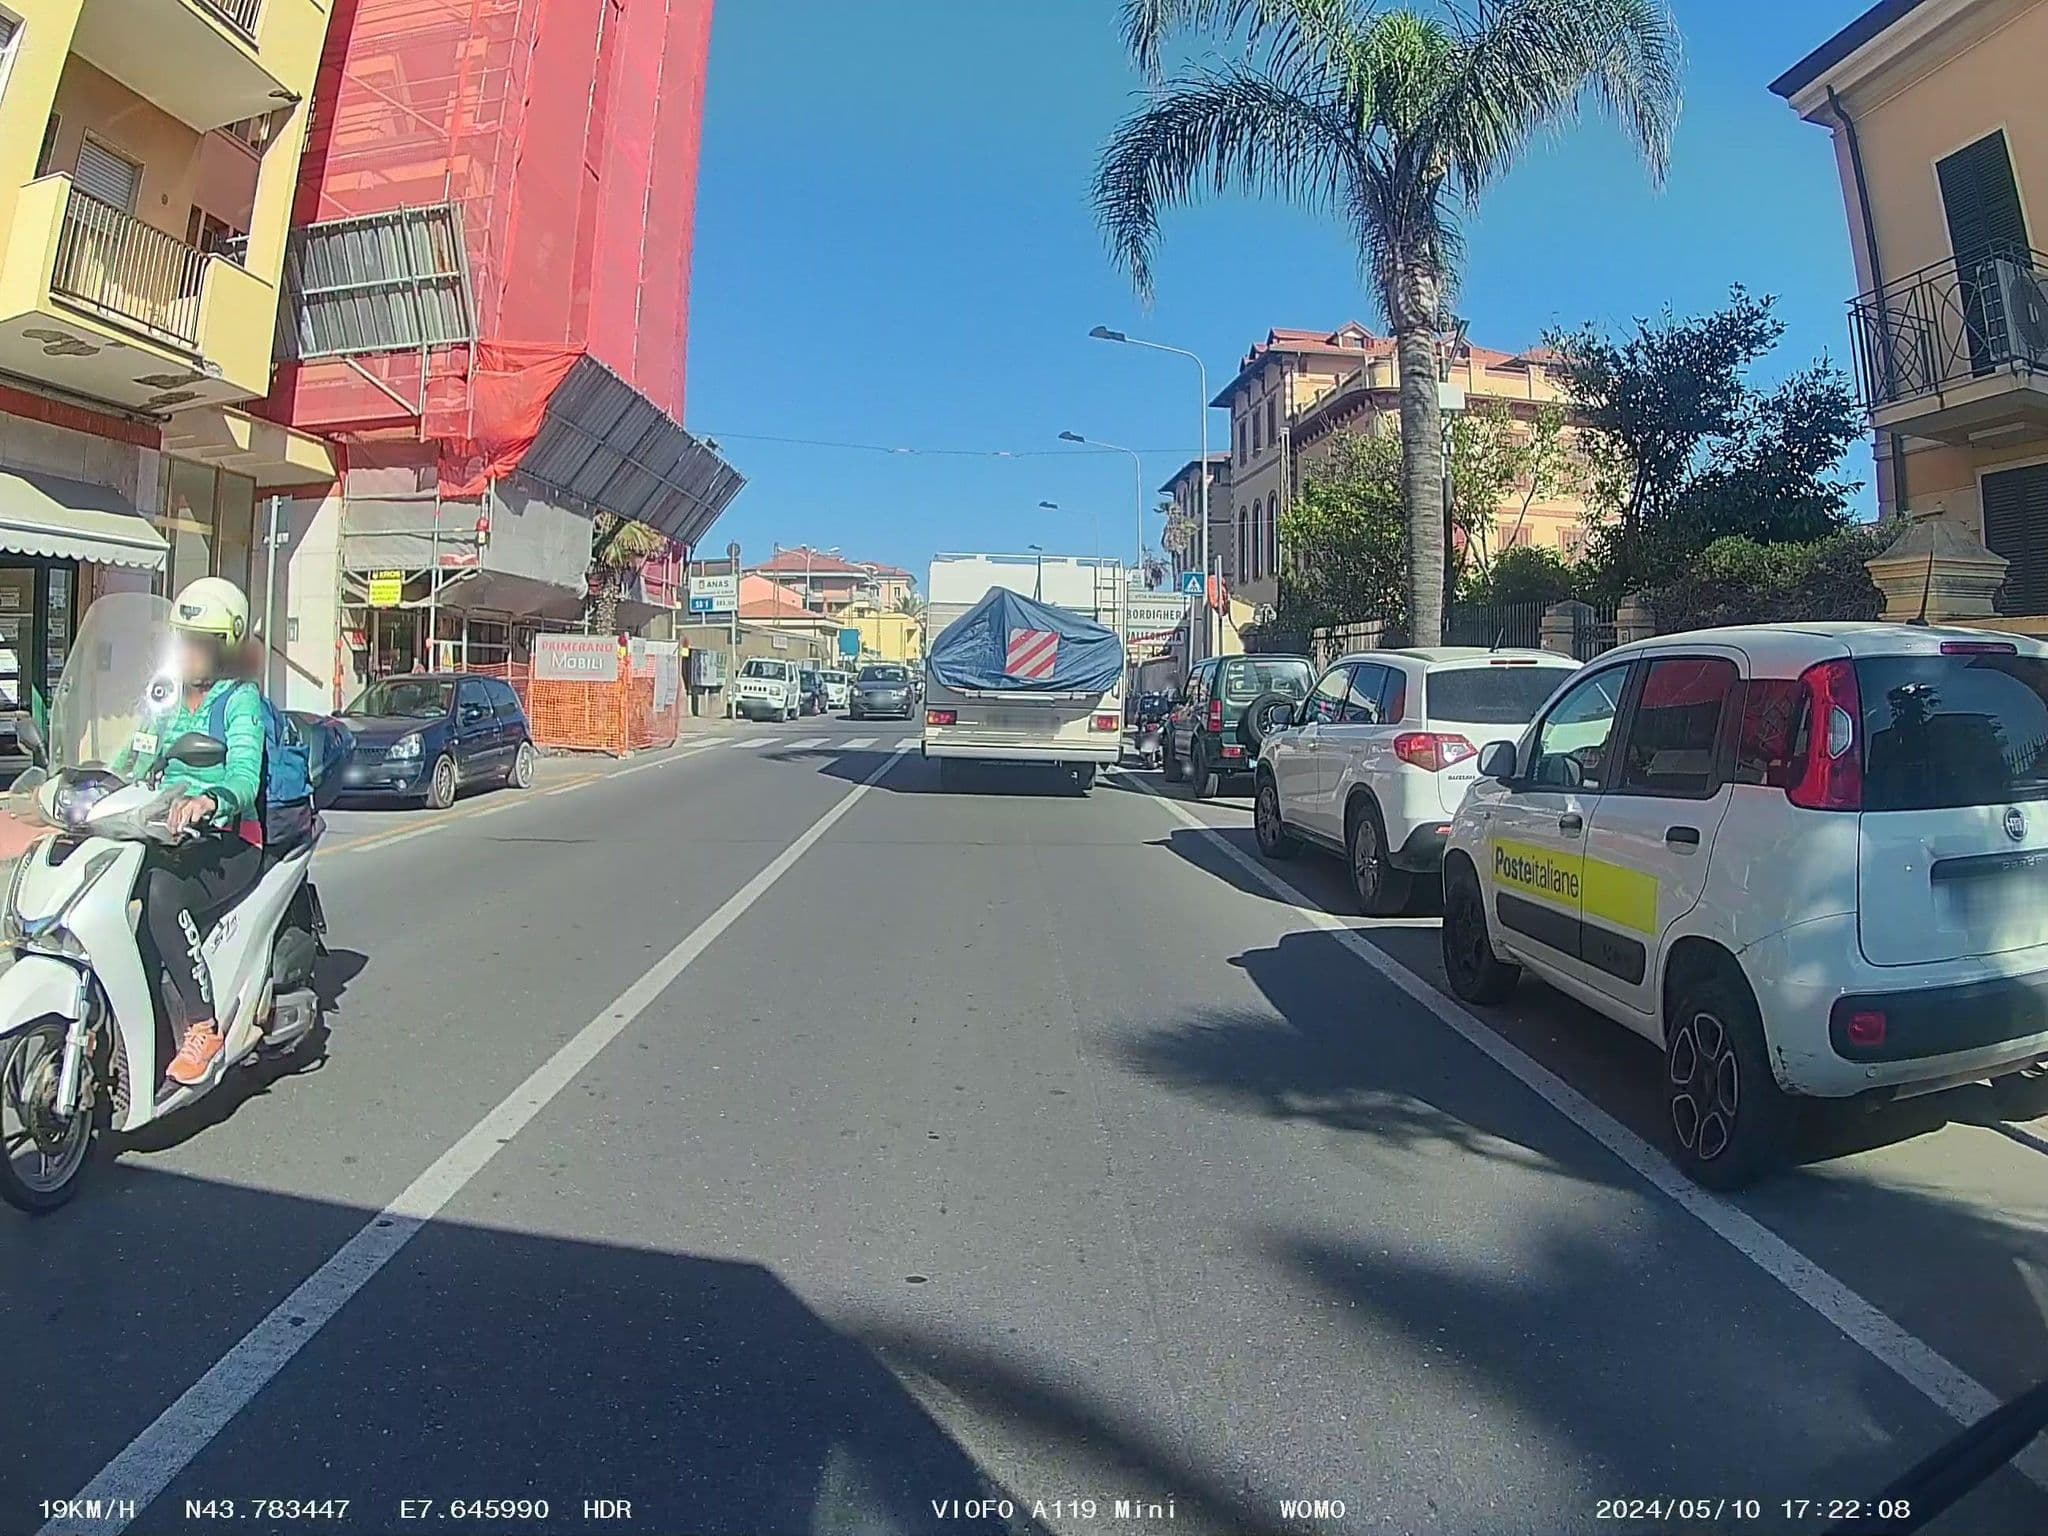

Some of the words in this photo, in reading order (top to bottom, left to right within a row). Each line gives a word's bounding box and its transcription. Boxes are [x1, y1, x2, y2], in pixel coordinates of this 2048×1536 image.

[706, 580, 729, 588] ANAS
[542, 642, 613, 653] PRIMERANO
[552, 653, 603, 669] MOBILI
[1495, 846, 1579, 898] Posteitaliane
[178, 910, 210, 1003] adidas
